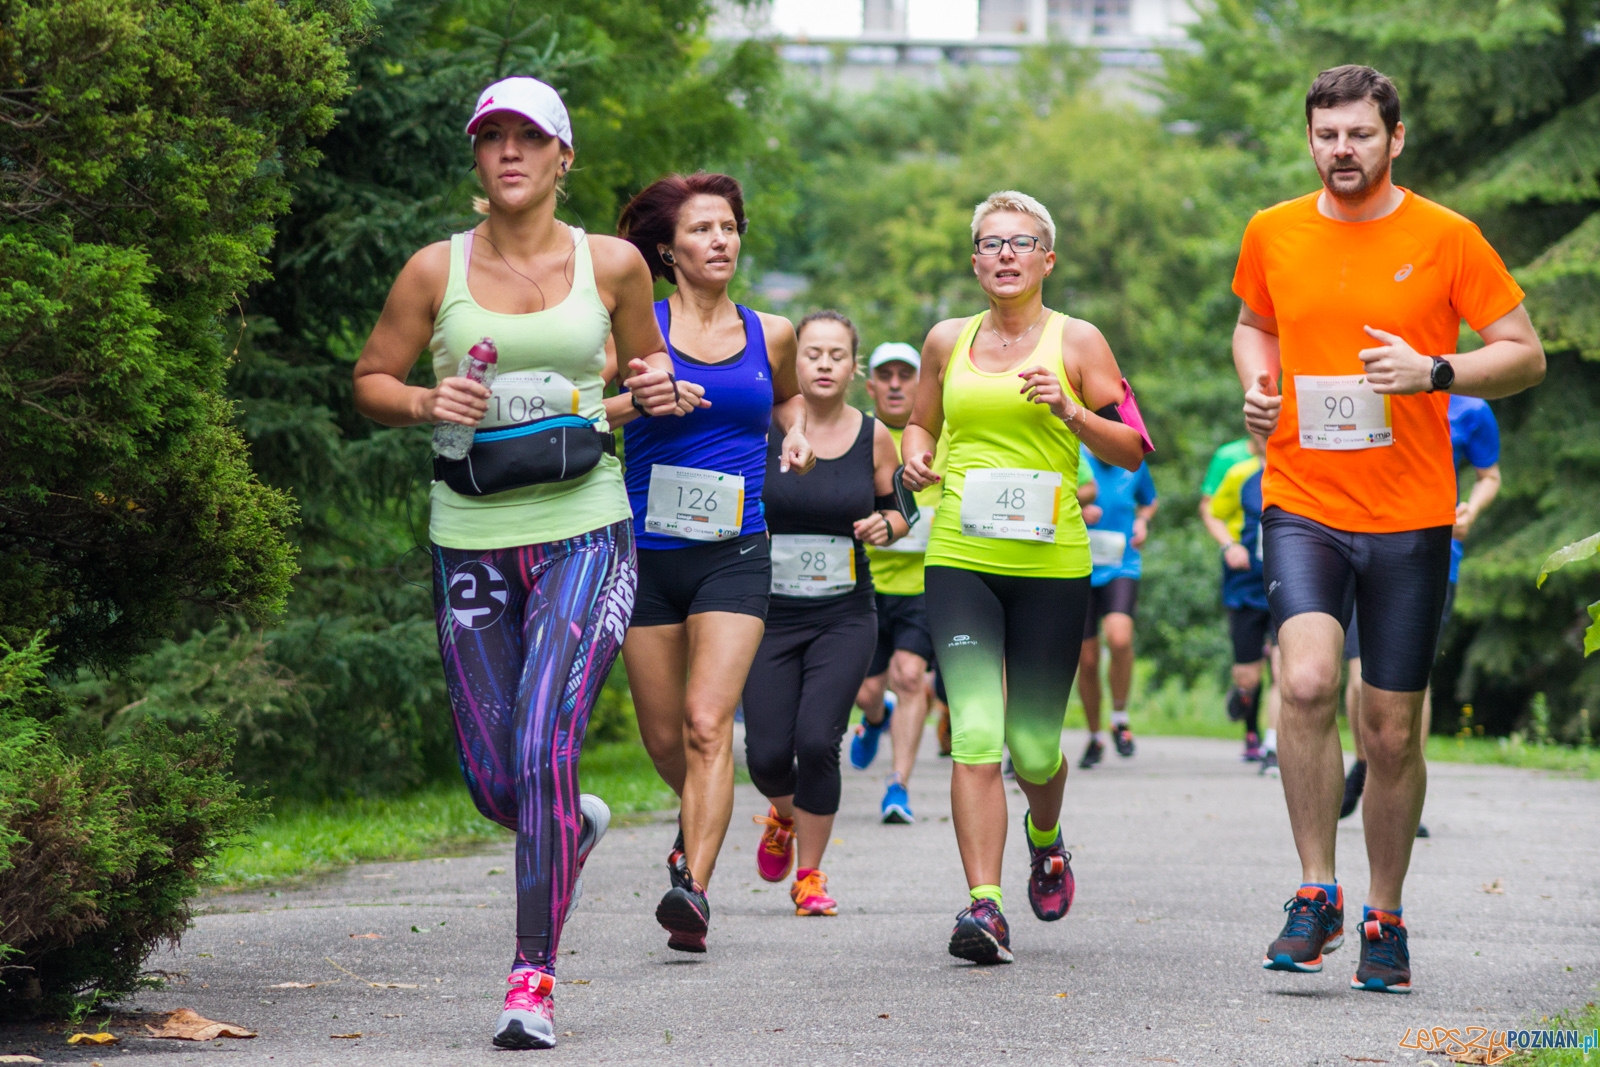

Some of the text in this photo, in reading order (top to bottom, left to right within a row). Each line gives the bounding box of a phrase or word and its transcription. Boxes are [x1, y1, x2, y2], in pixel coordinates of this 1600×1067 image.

[493, 395, 546, 422] 108
[1324, 396, 1354, 419] 90
[677, 486, 717, 512] 126
[996, 488, 1025, 510] 48
[801, 551, 827, 571] 98
